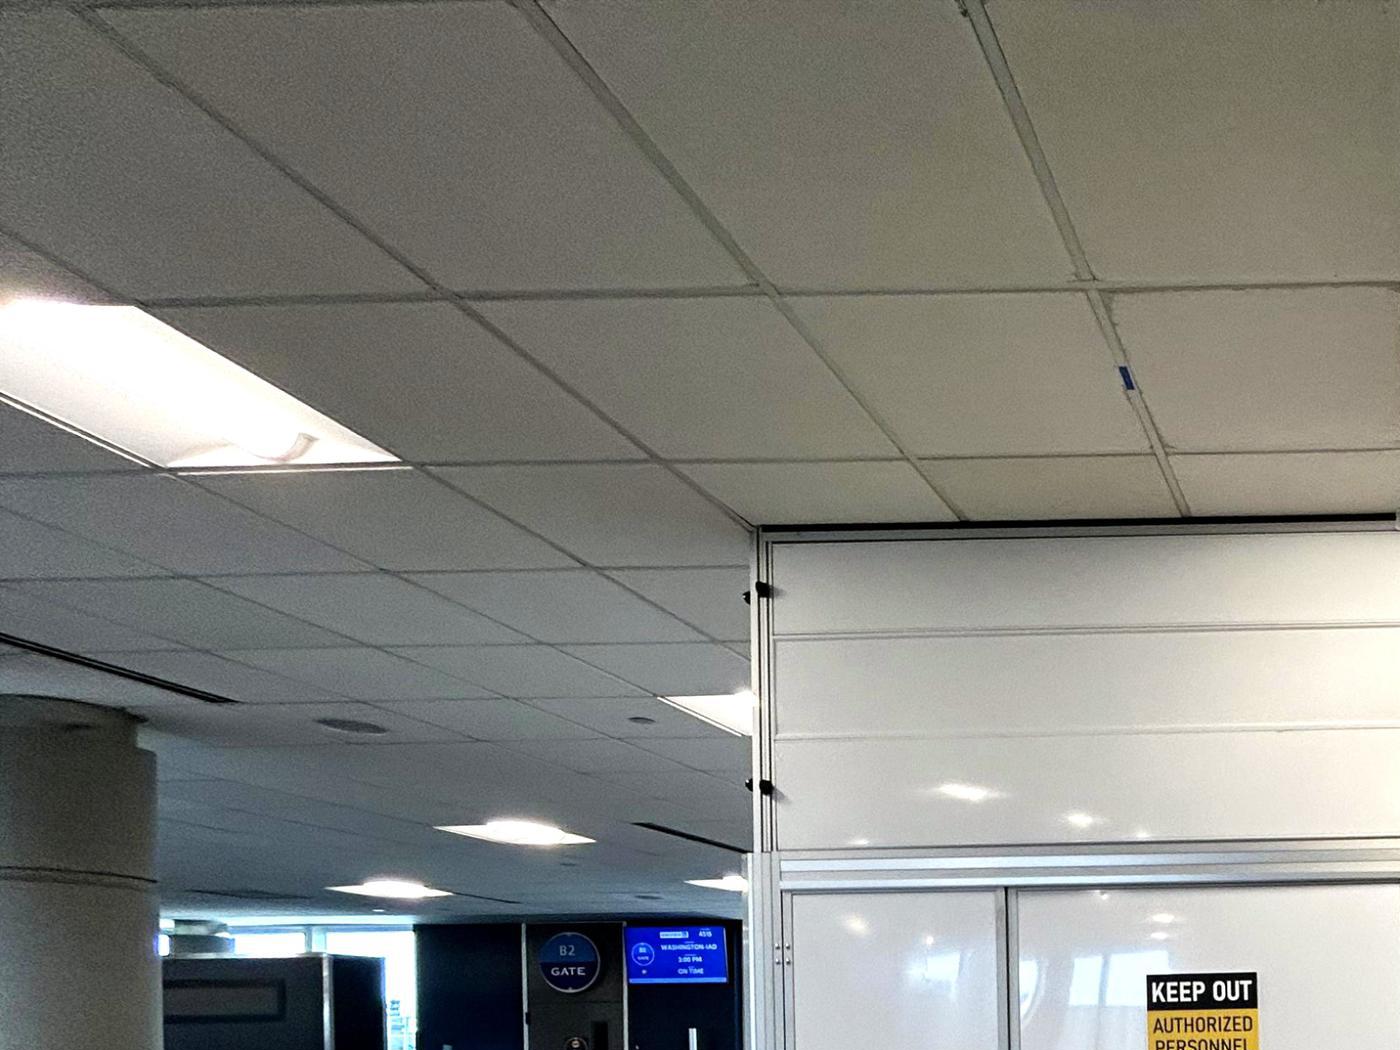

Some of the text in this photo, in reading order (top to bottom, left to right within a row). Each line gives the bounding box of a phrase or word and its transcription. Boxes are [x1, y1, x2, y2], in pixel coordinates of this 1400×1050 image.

[559, 944, 576, 956] B2
[550, 967, 586, 976] GATE
[1152, 980, 1253, 1003] KEEP OUT
[1153, 1015, 1254, 1034] AUTHORIZED
